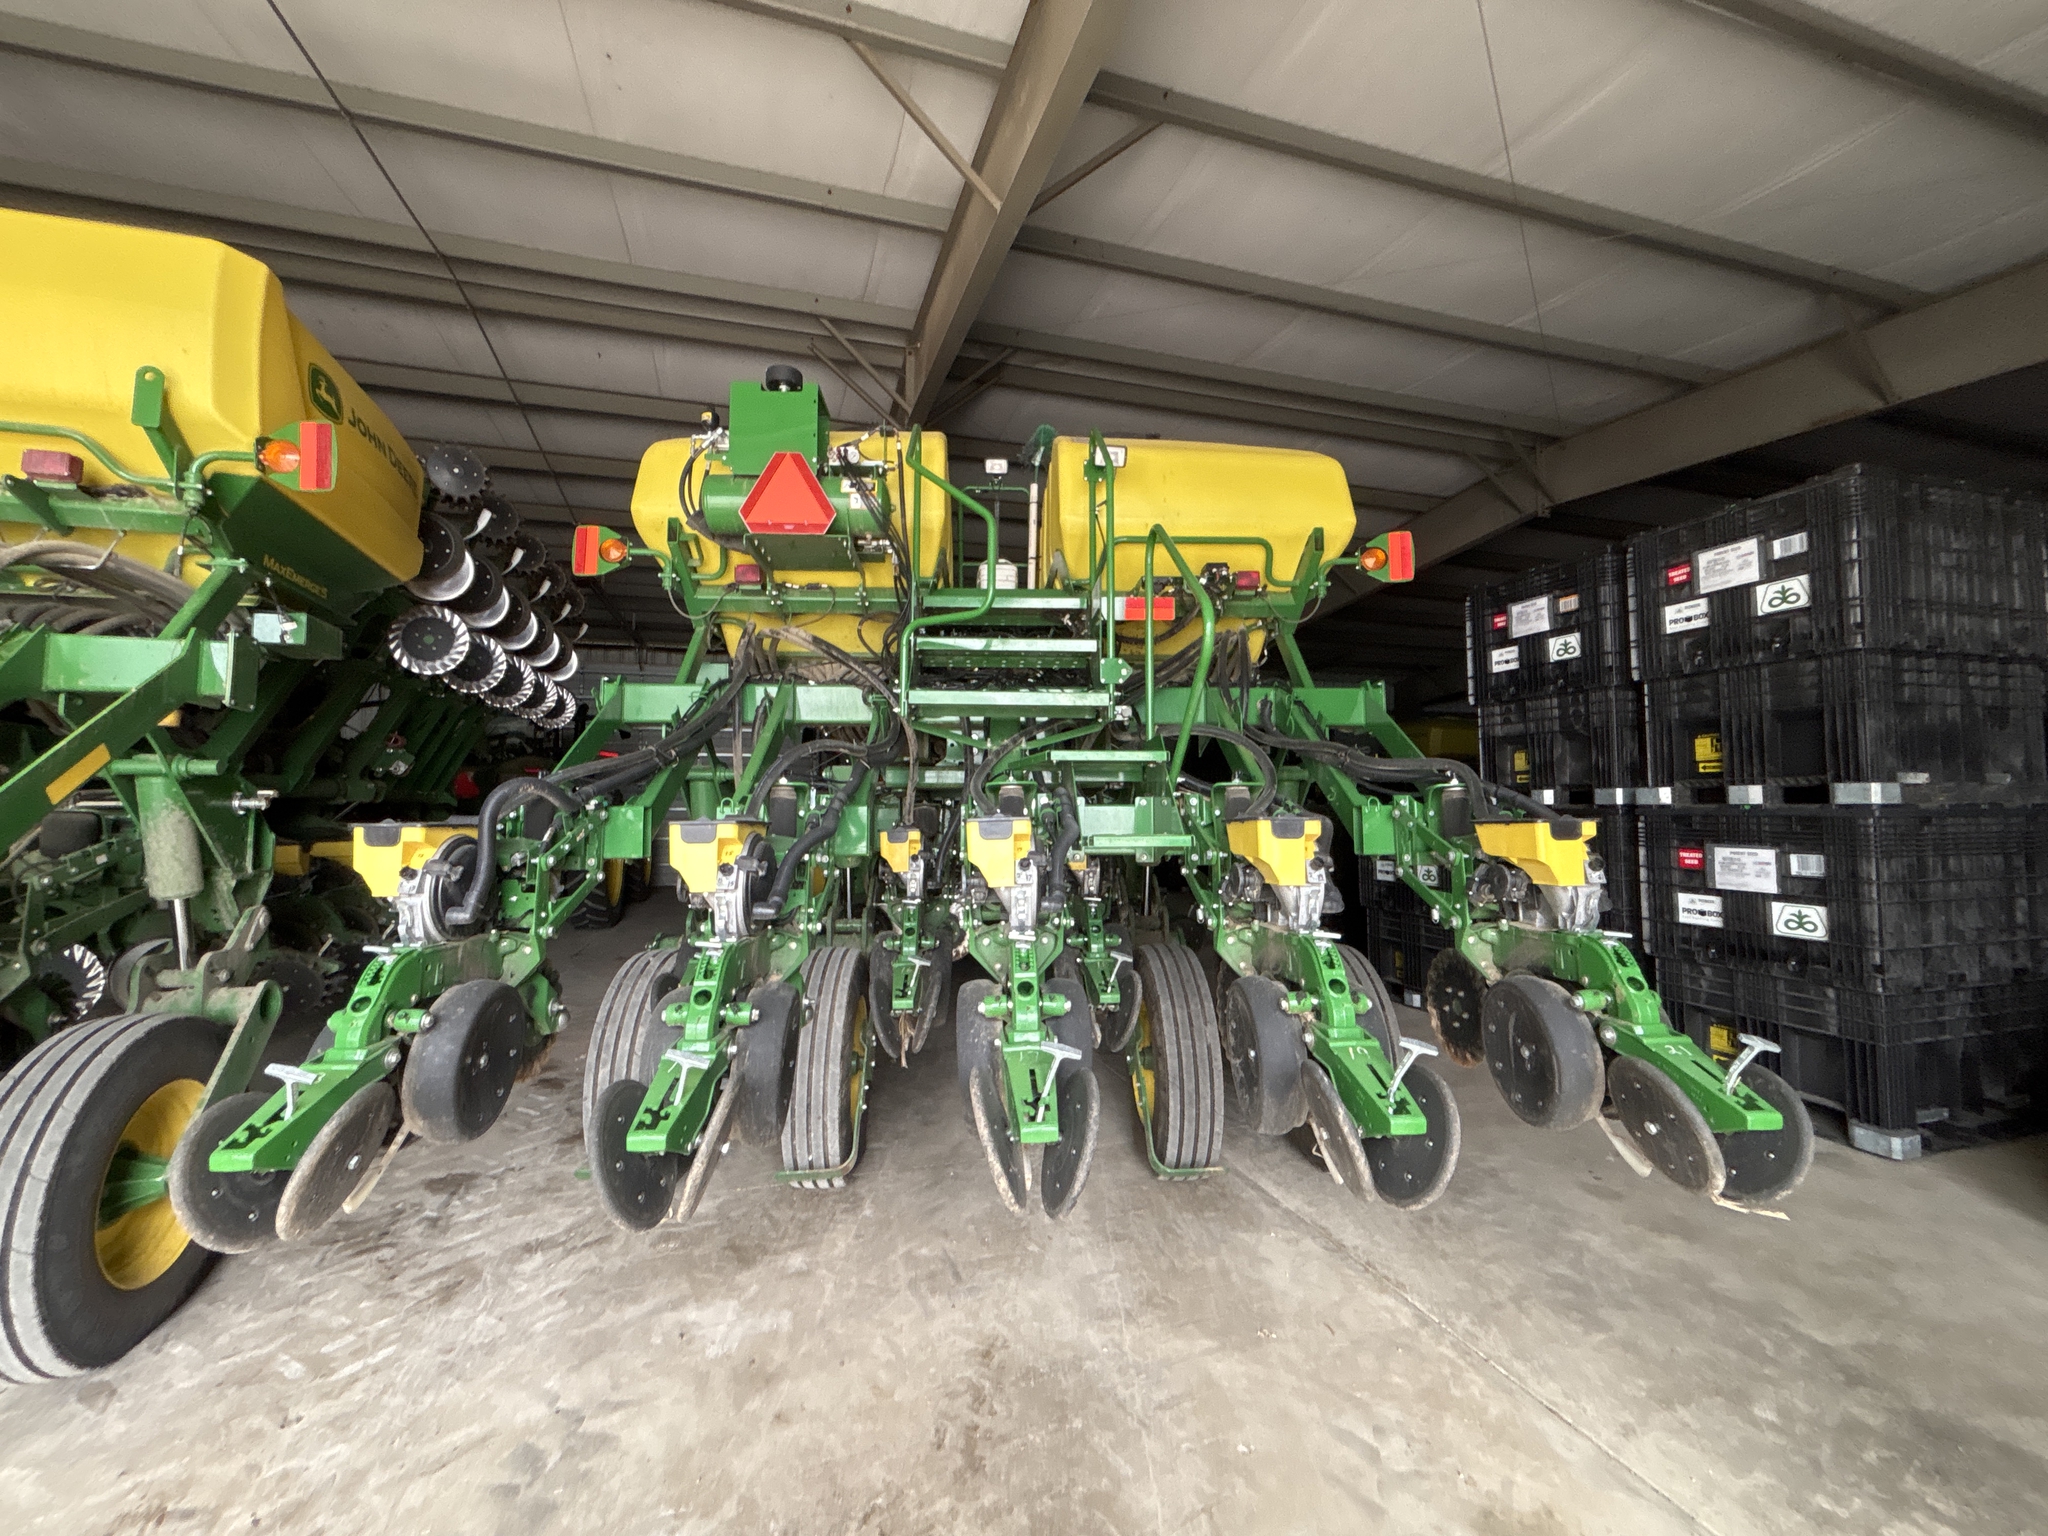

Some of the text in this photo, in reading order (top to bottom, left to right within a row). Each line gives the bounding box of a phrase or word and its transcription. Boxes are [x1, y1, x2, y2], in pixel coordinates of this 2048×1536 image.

[348, 407, 388, 457] JOHN
[1669, 617, 1684, 626] PRO
[1682, 907, 1723, 918] PRO BOX
[1664, 1044, 1693, 1057] 21
